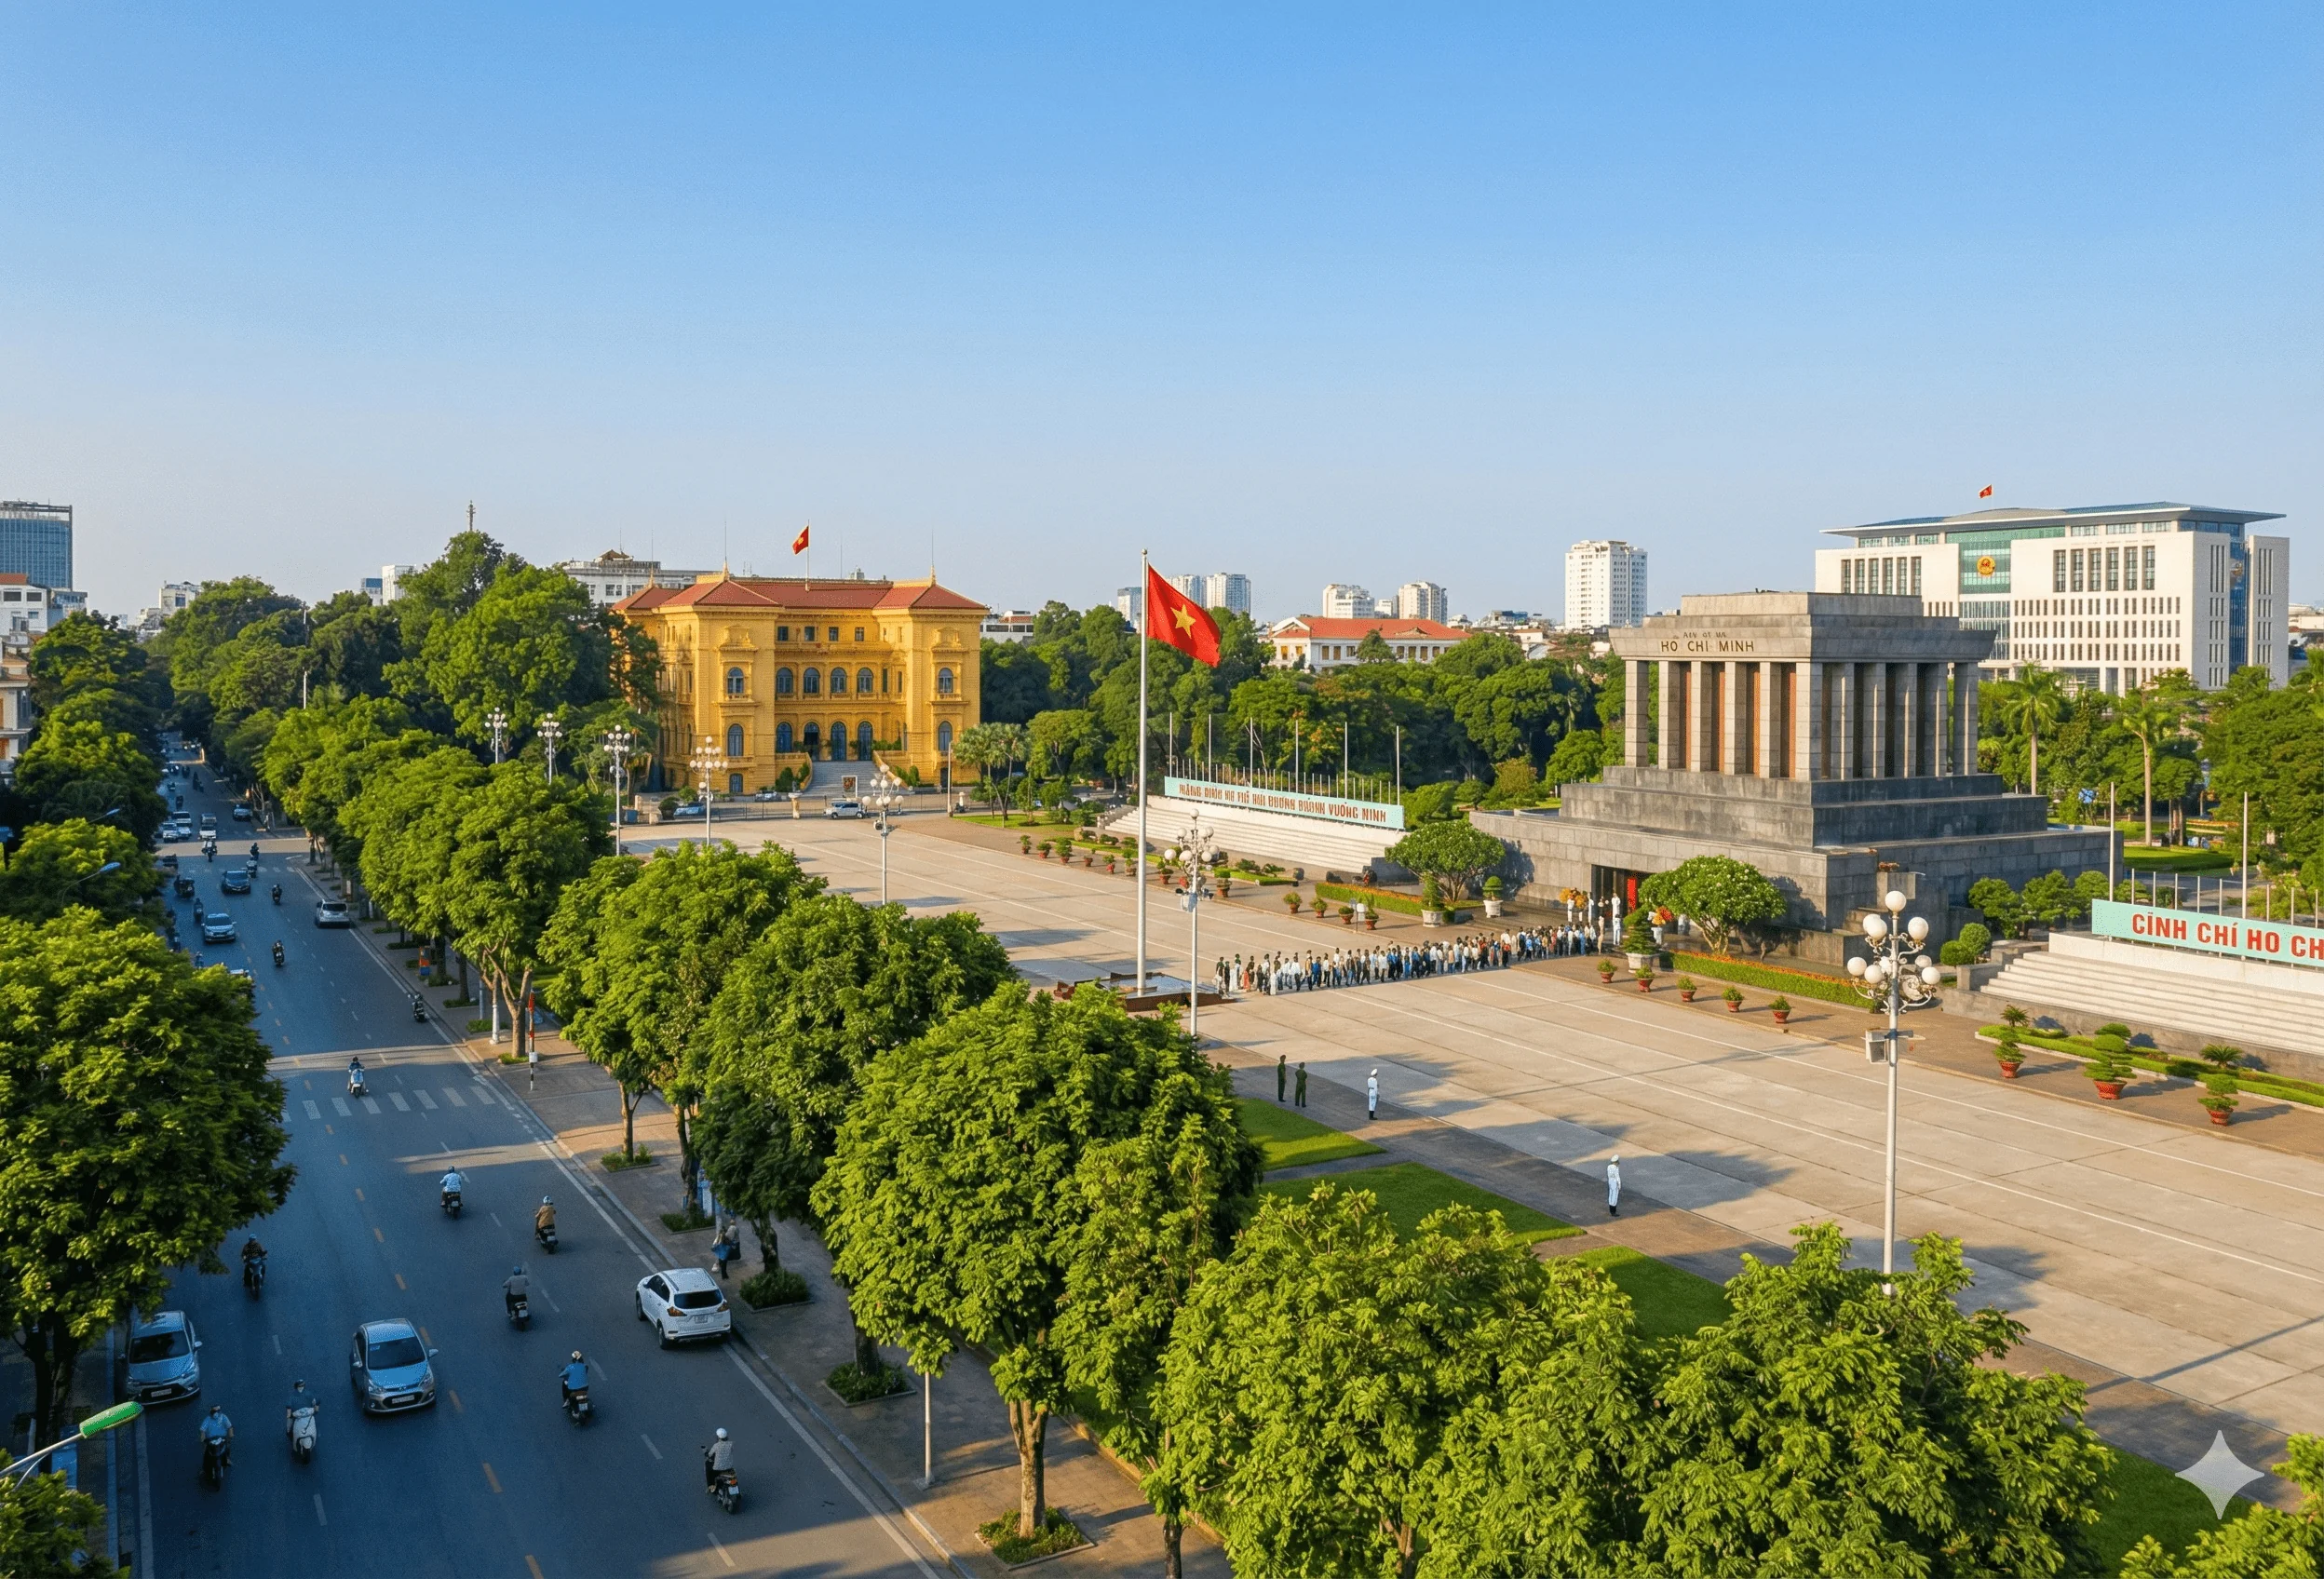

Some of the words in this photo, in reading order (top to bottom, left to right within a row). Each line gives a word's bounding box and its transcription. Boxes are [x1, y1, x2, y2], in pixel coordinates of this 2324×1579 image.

[1687, 641, 1709, 652] CHI
[1719, 640, 1754, 653] MINH
[2197, 922, 2237, 948] CHÍ
[2247, 928, 2280, 953] HO
[2290, 935, 2324, 960] CH
